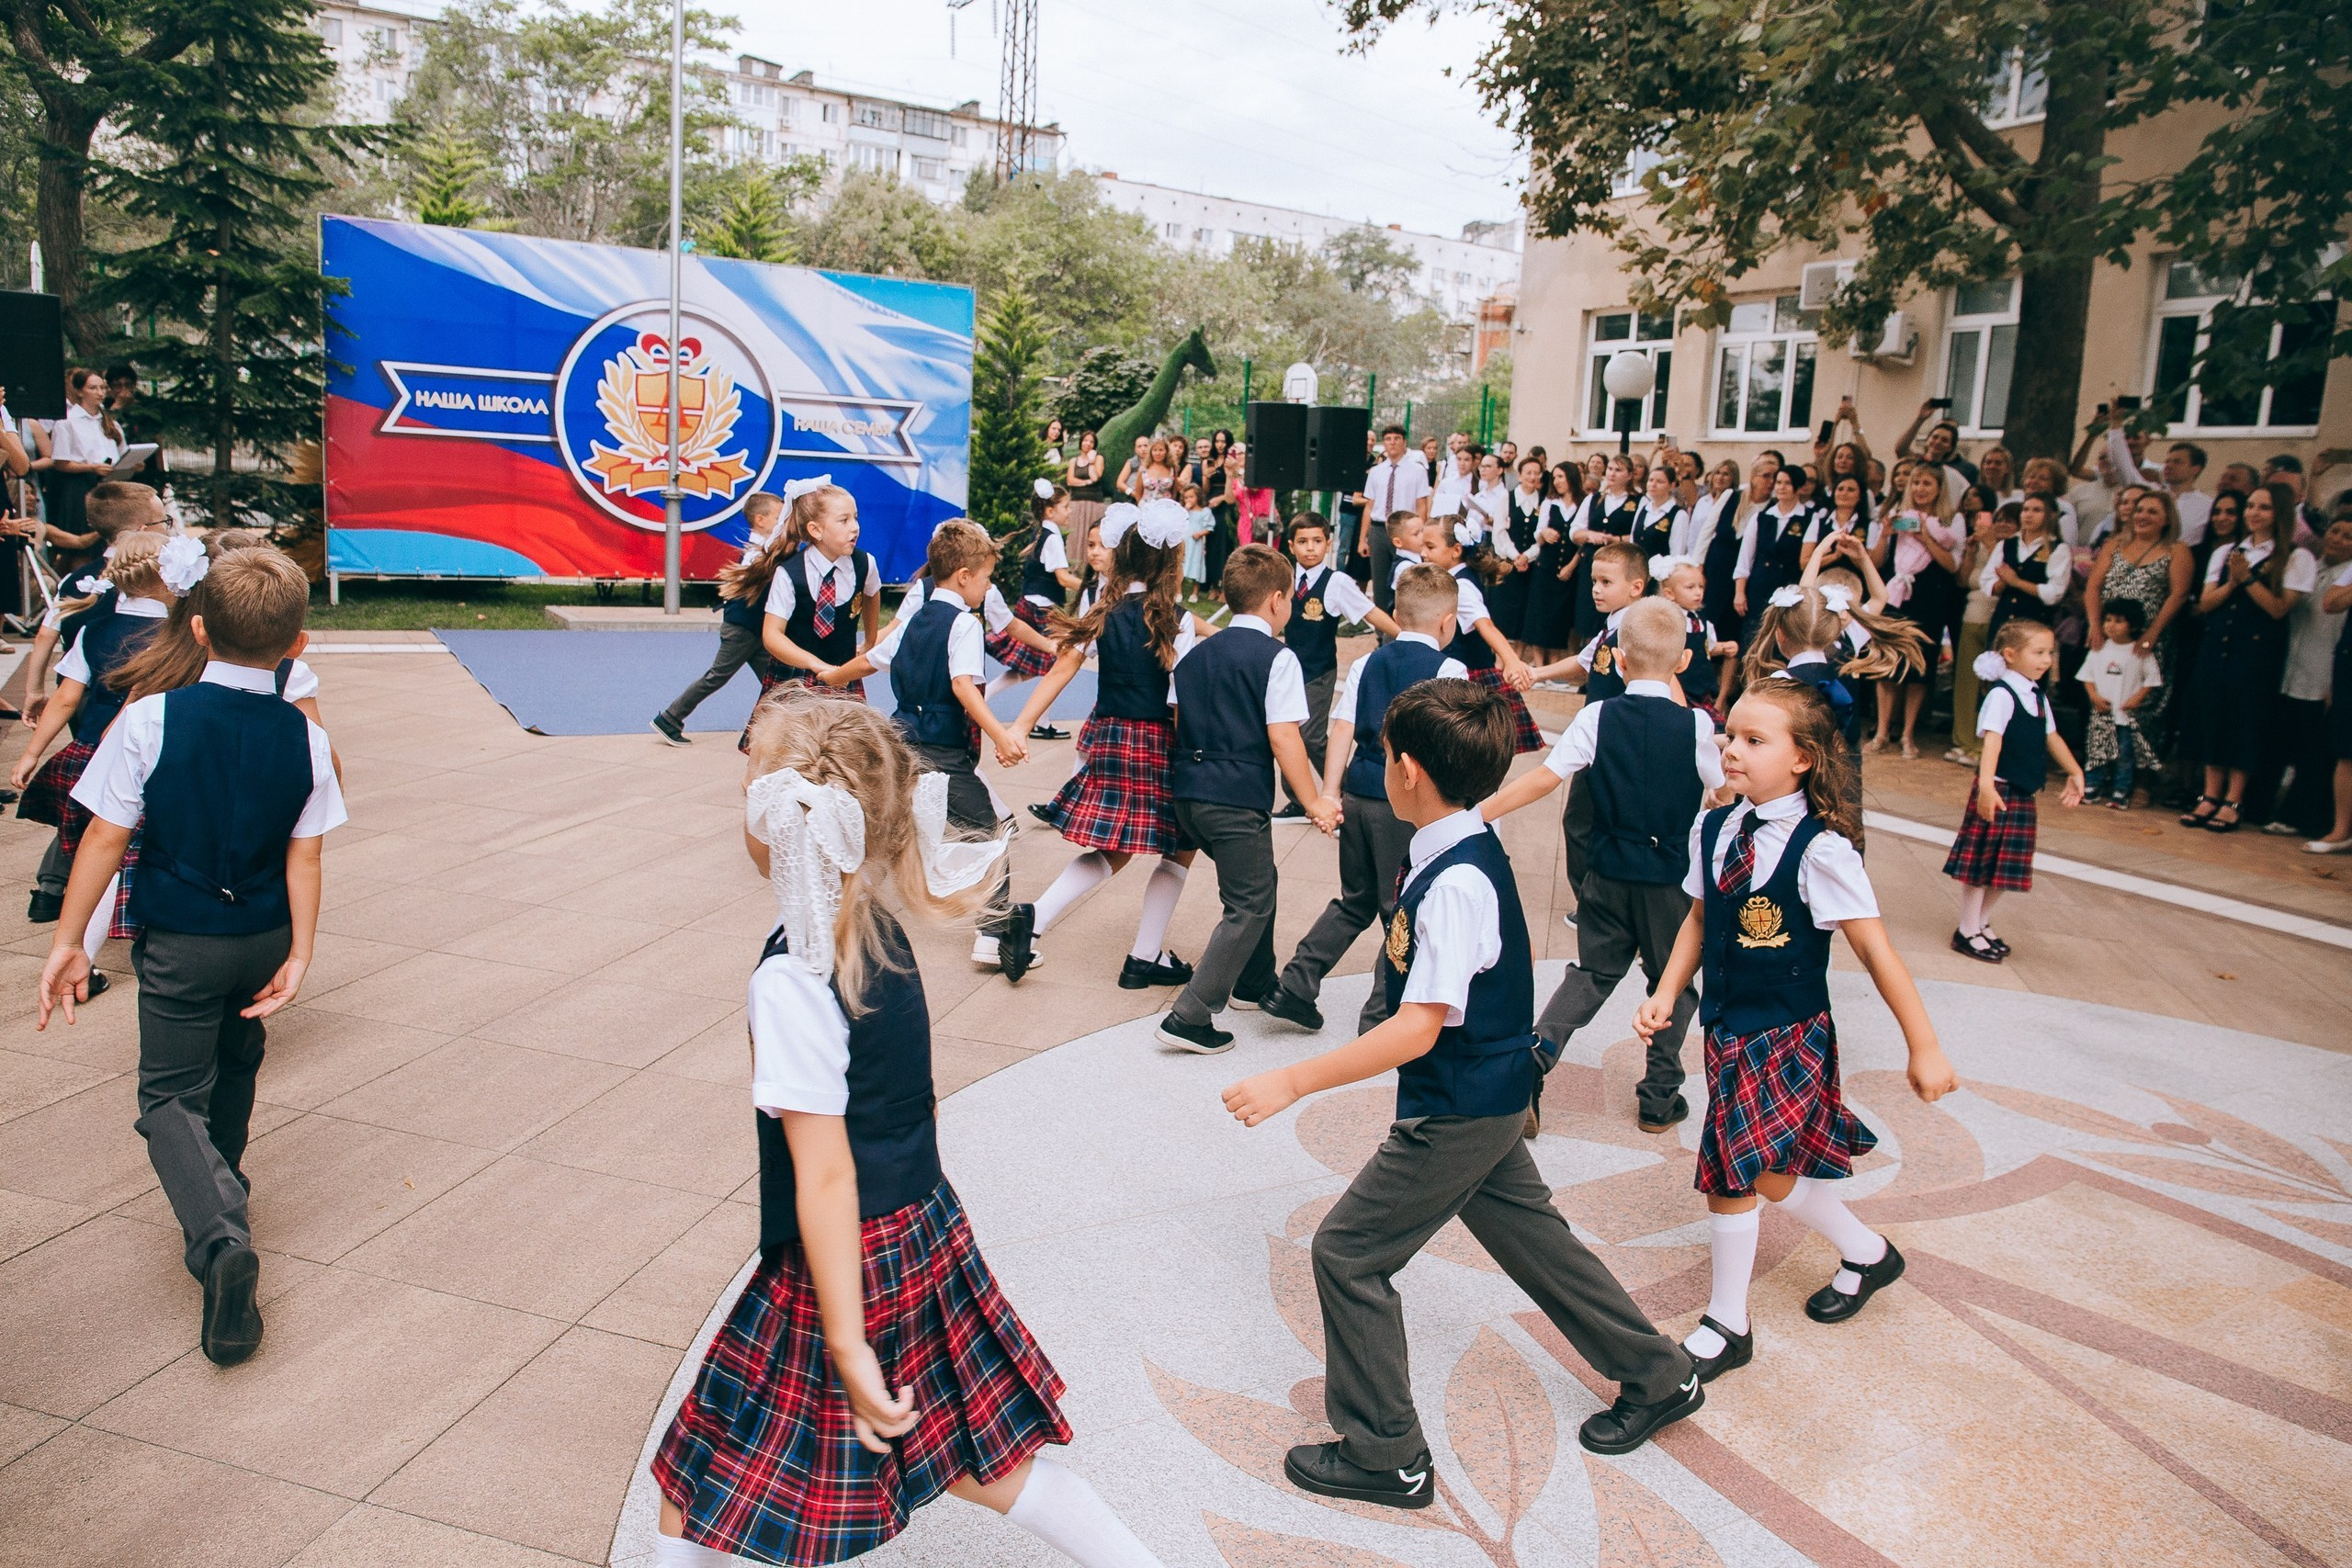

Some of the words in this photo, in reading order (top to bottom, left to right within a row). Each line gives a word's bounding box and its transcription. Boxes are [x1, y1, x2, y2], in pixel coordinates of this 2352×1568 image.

[415, 389, 475, 411] НАША
[478, 394, 549, 415] ШКОЛА
[794, 418, 839, 434] НАША
[842, 420, 892, 437] СЕМЬЯ
